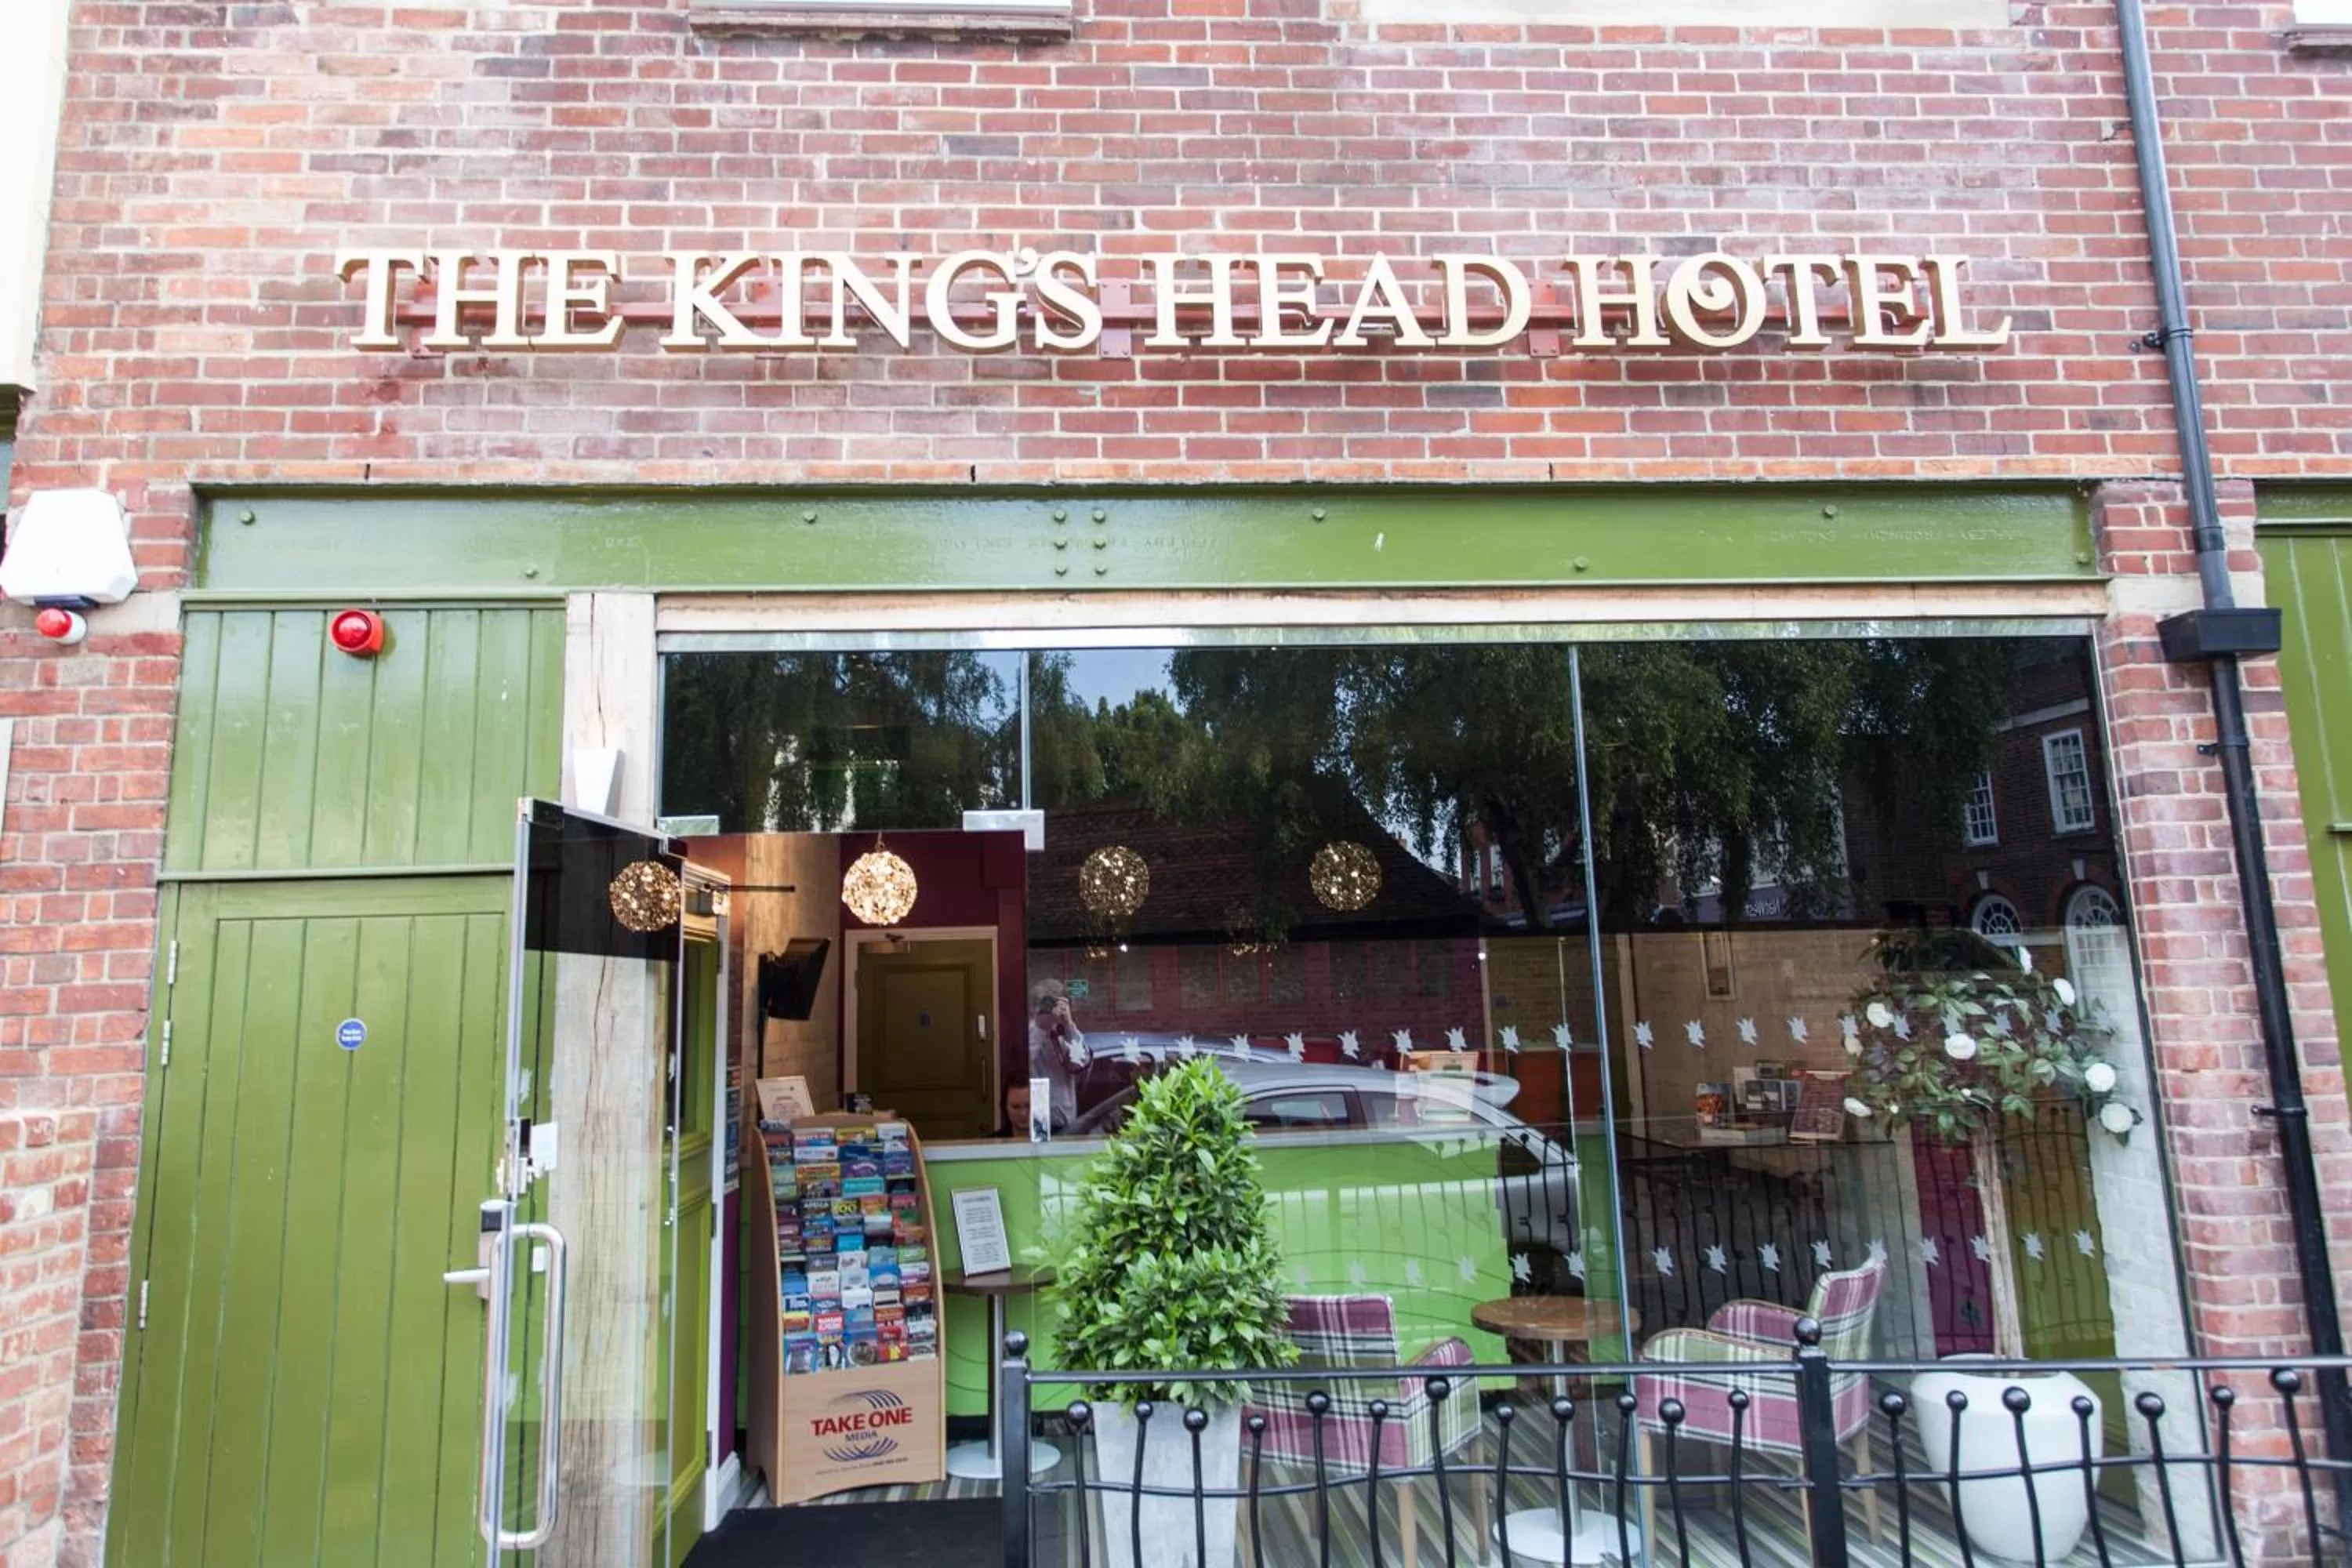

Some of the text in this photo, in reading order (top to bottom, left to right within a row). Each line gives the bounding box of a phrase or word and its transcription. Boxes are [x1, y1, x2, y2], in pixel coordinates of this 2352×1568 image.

[335, 249, 2013, 353] THE KING'S HEAD HOTEL
[811, 1406, 913, 1437] TAKE ONE
[845, 1430, 878, 1442] MEDIA
